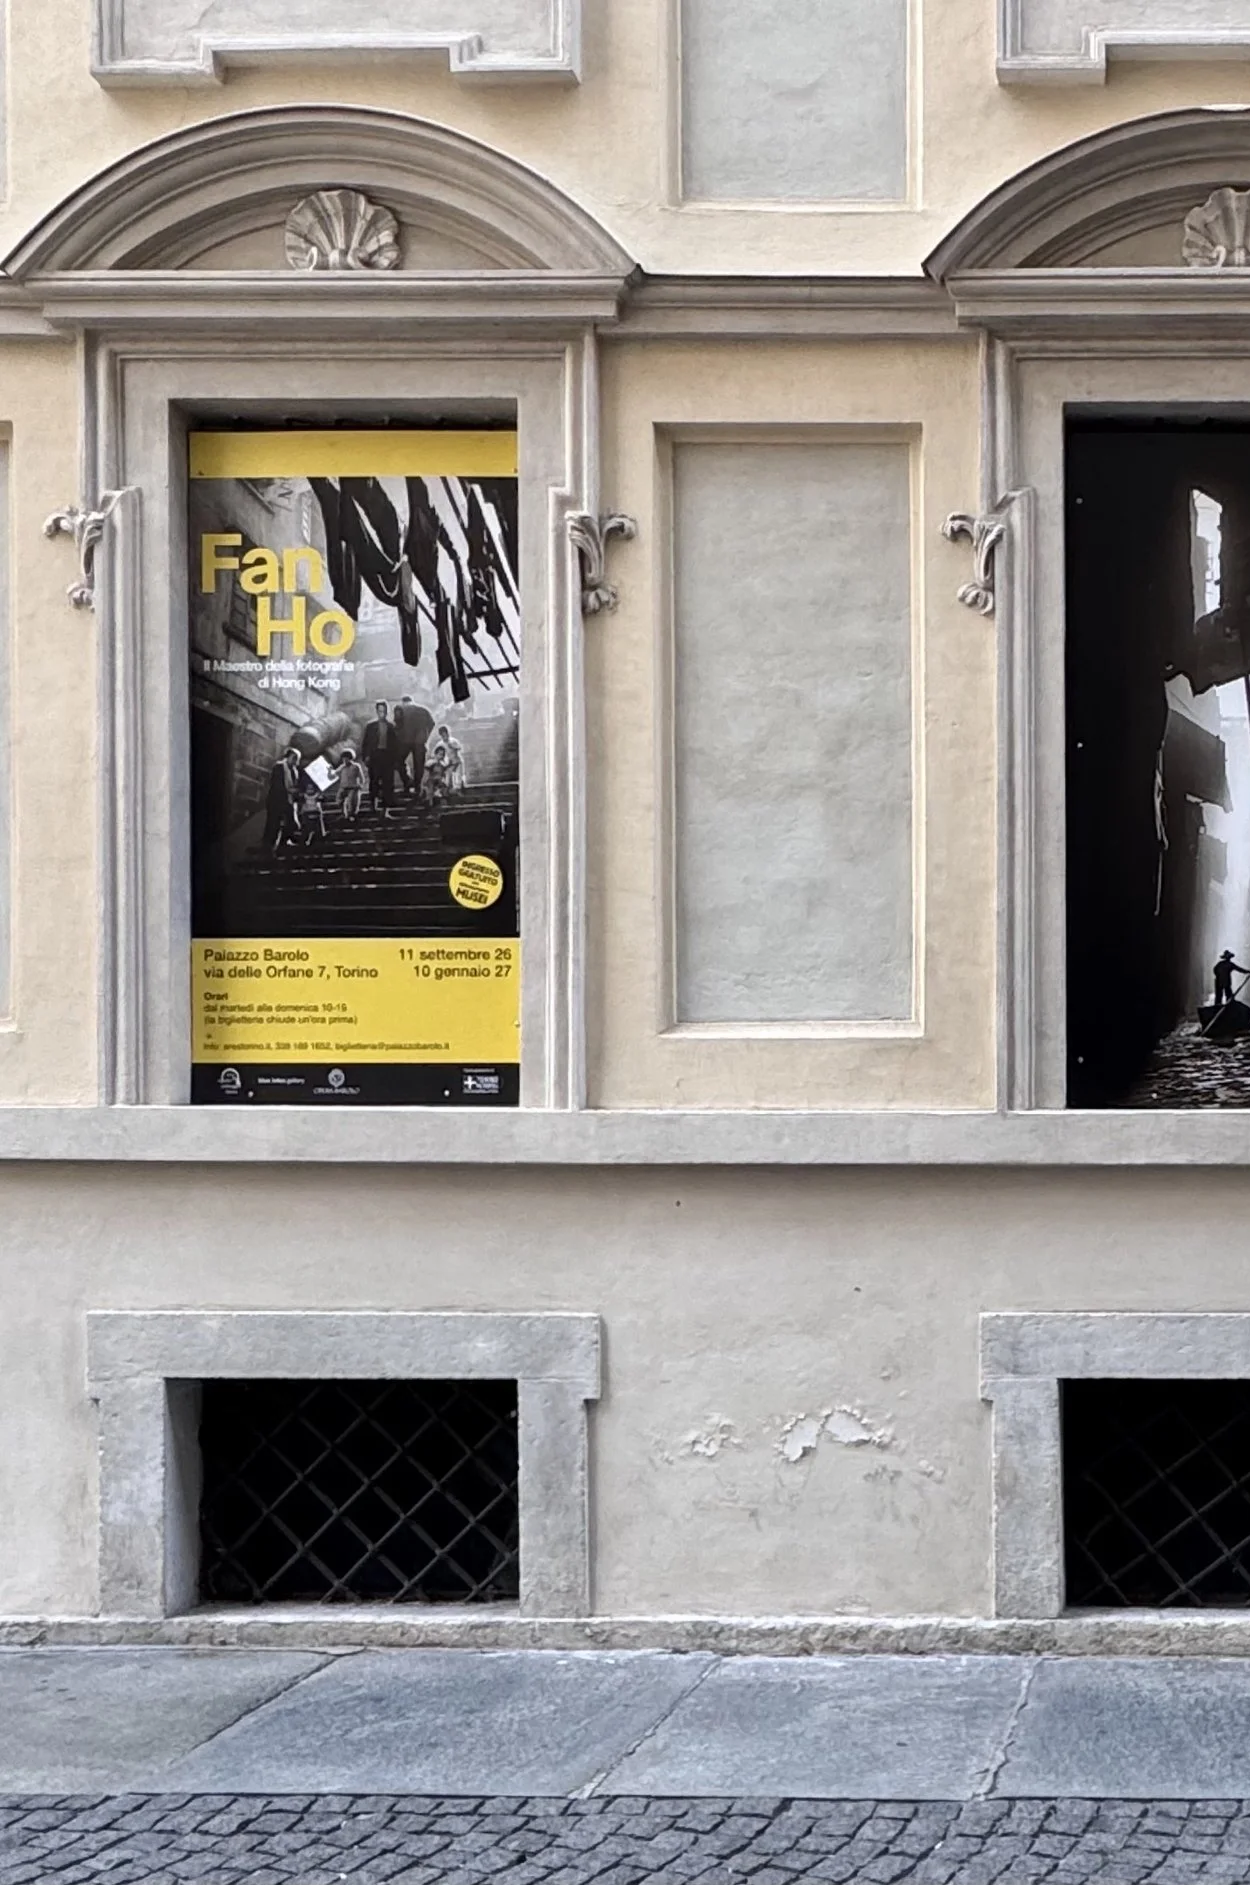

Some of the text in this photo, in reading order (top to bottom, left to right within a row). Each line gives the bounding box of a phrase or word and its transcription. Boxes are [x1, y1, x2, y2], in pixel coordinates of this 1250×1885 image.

[201, 533, 323, 594] Fan
[256, 595, 355, 657] Ho
[203, 659, 355, 674] Il Maestro della fotografia
[258, 677, 341, 691] di Hong Kong
[456, 887, 489, 905] MUSEI
[203, 948, 310, 962] Palazzo Barolo
[399, 948, 512, 961] 11 settembre 26
[203, 965, 379, 981] via delle Orfane 7, Torino
[413, 965, 512, 981] 10 gennaio 27
[203, 992, 228, 1000] Orari
[203, 1004, 217, 1012] dal
[256, 1004, 273, 1012] alla
[275, 1004, 319, 1012] domenica
[218, 1016, 264, 1026] biglietteria
[265, 1016, 296, 1025] chiude
[298, 1016, 326, 1024] un'ora
[328, 1015, 358, 1025] prima)
